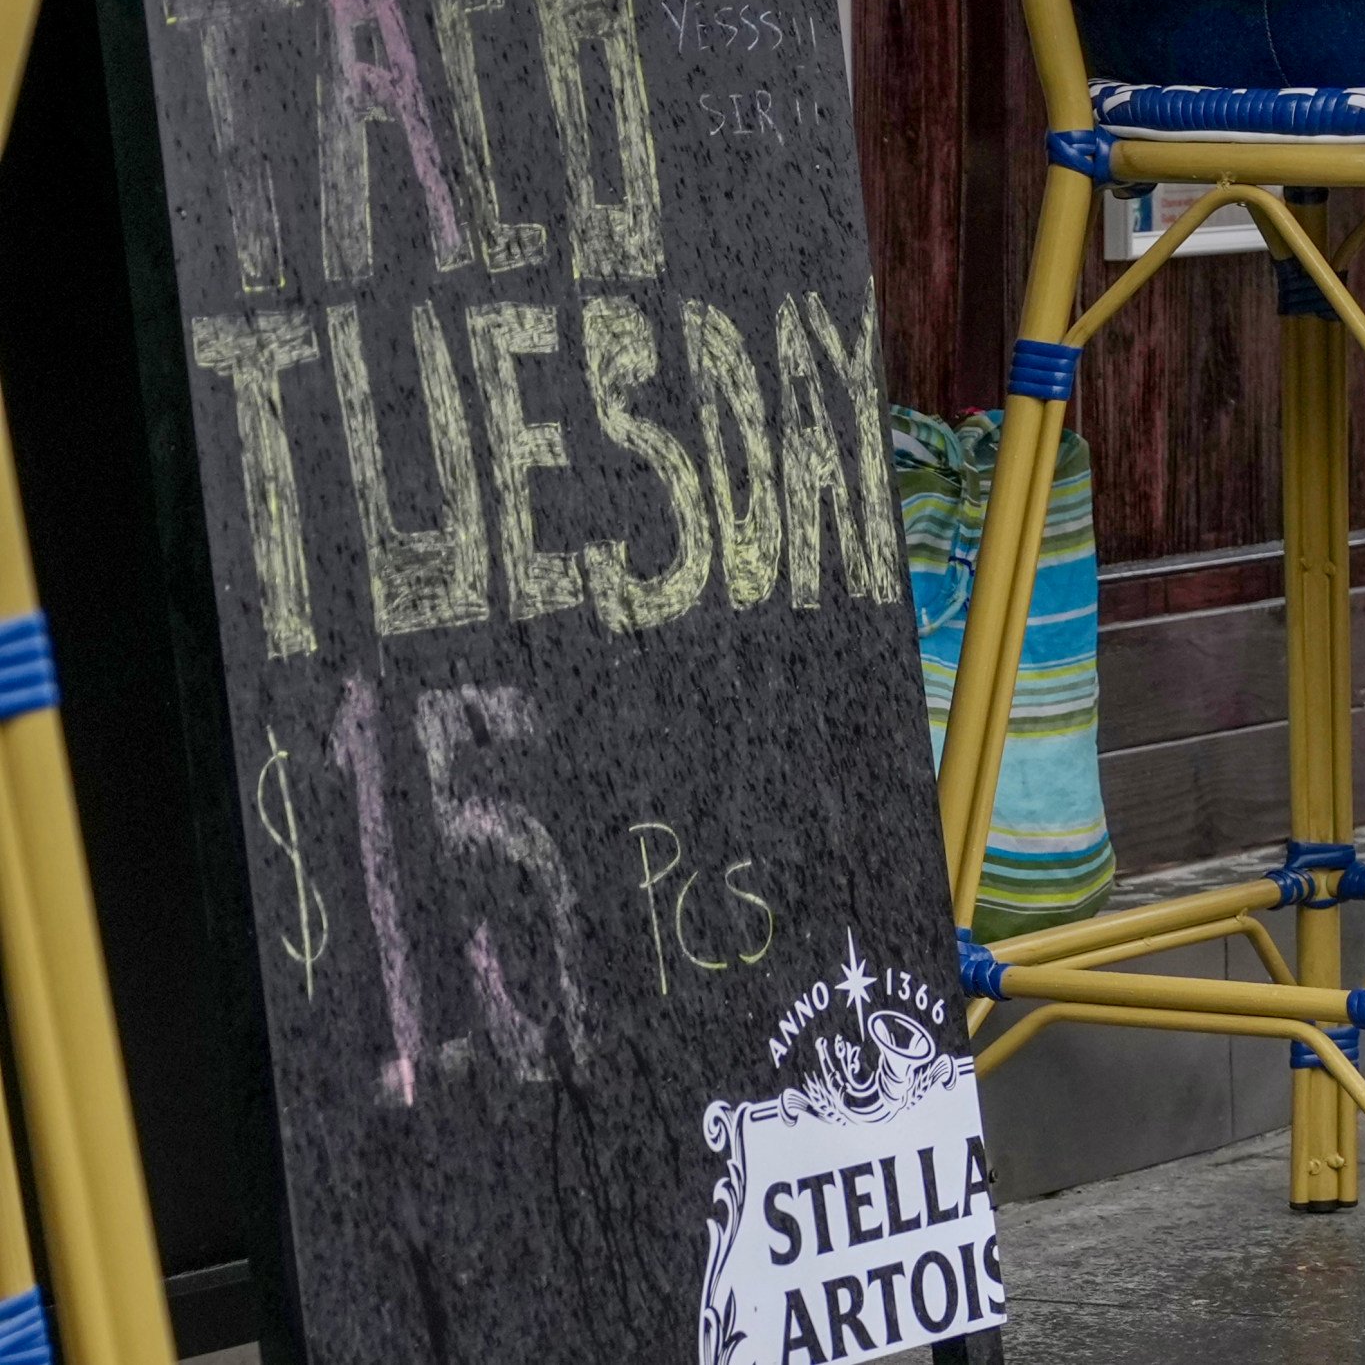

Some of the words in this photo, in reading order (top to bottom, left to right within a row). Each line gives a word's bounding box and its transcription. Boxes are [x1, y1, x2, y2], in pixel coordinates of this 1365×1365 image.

[191, 275, 901, 660] TUESDAY
[769, 981, 830, 1069] ANNO
[886, 967, 945, 1025] 1366
[763, 1135, 998, 1266] STELLA
